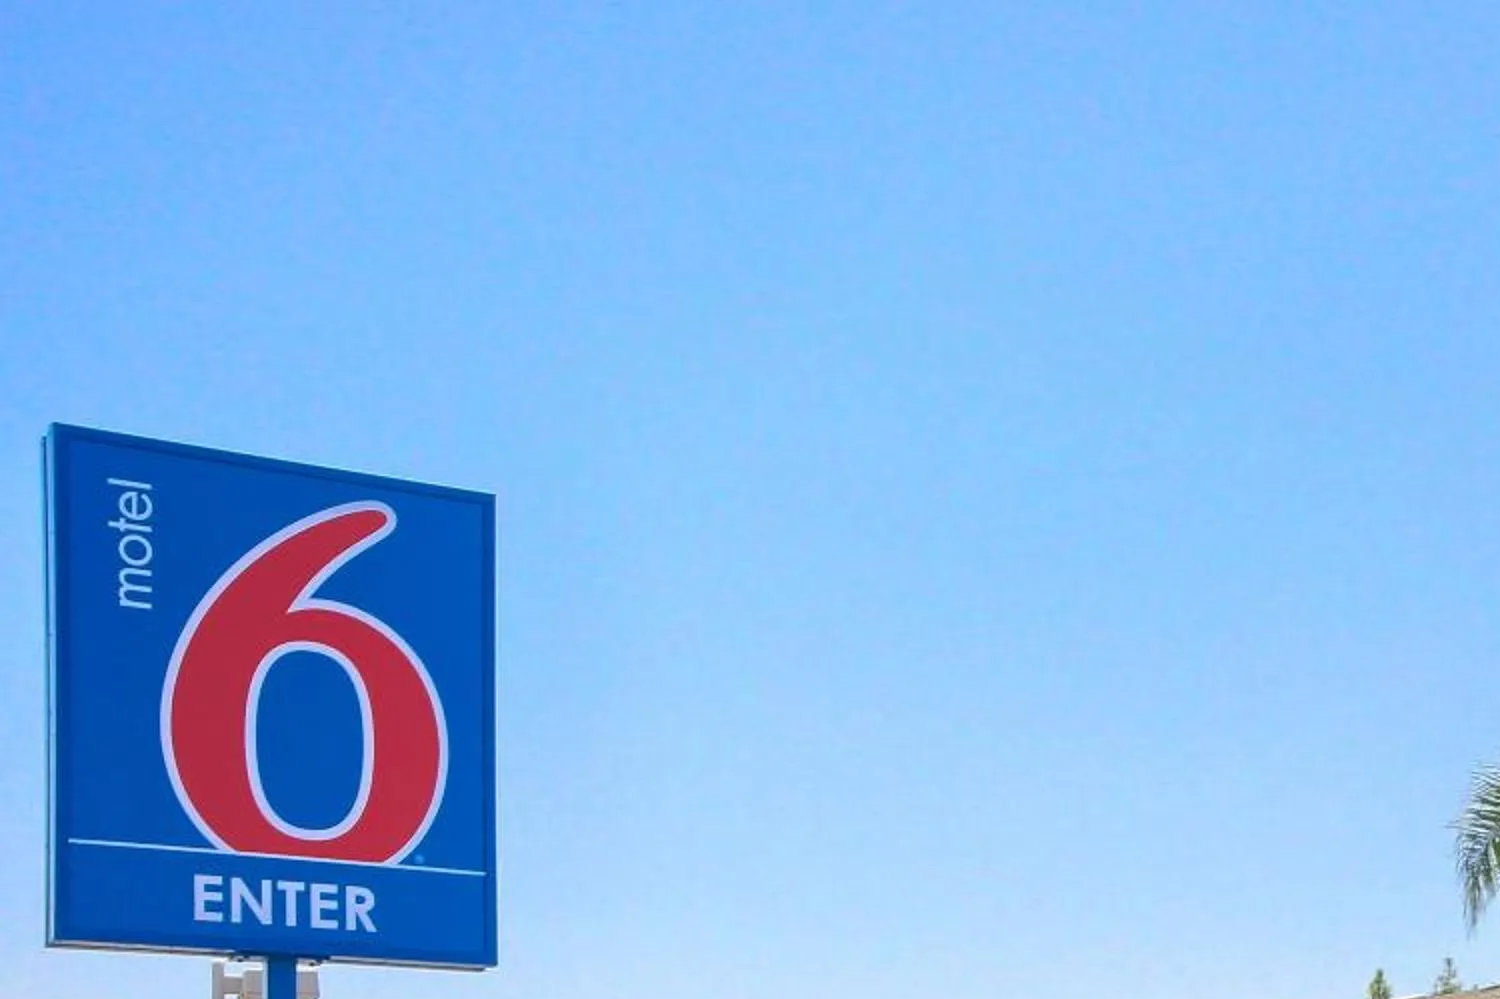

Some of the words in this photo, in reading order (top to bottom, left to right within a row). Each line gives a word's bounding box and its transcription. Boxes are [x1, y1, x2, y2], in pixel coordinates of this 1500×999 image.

[107, 478, 152, 609] motel
[160, 500, 449, 867] 6
[193, 874, 378, 933] ENTER
